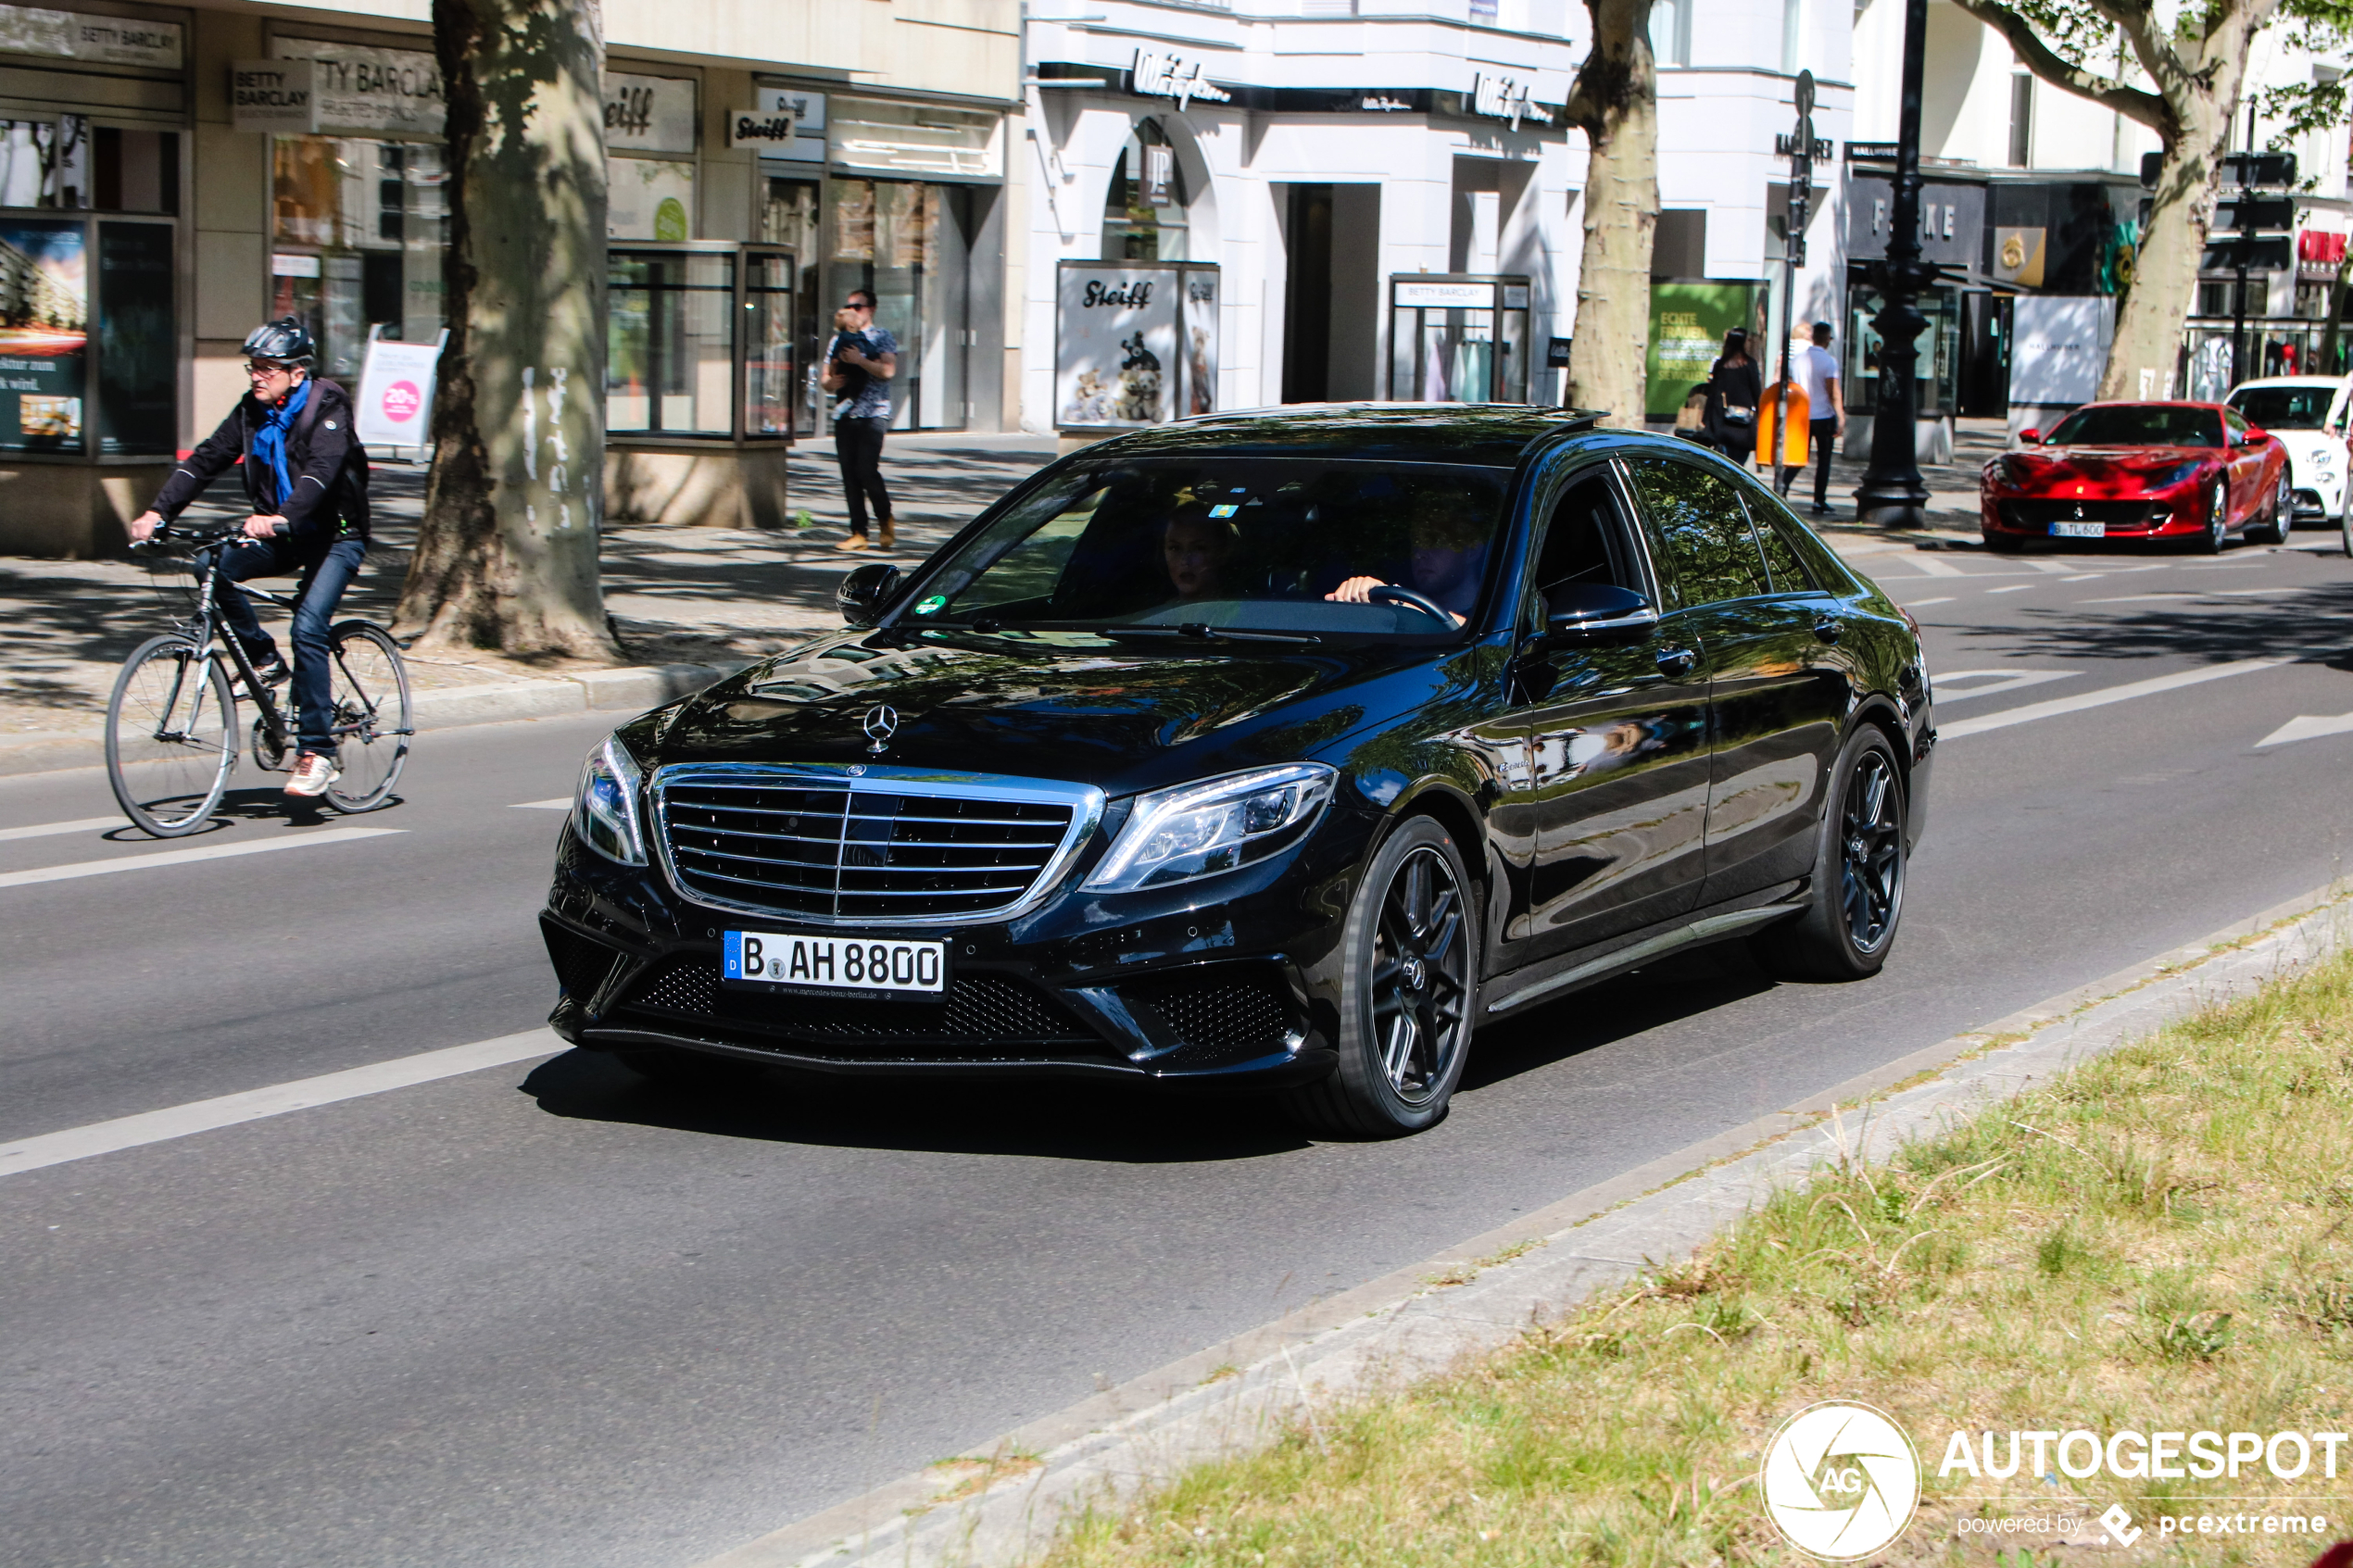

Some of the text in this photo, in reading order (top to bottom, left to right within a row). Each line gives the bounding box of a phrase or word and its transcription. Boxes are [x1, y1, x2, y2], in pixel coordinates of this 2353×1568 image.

[235, 71, 285, 87] BETTY
[358, 63, 446, 98] BARCLA
[235, 91, 308, 107] BARCLAY
[735, 116, 789, 140] Steiff
[1082, 280, 1153, 309] Steiff
[1408, 287, 1479, 298] BETTY BARCLAY
[1661, 312, 1697, 325] ECHTE
[1661, 326, 1707, 339] FRAUEN
[2069, 524, 2081, 535] TL
[2083, 524, 2103, 535] 600
[729, 960, 736, 971] D
[744, 937, 938, 985] B AH 8800
[782, 987, 877, 999] www.mercedes-benz-berlin.de
